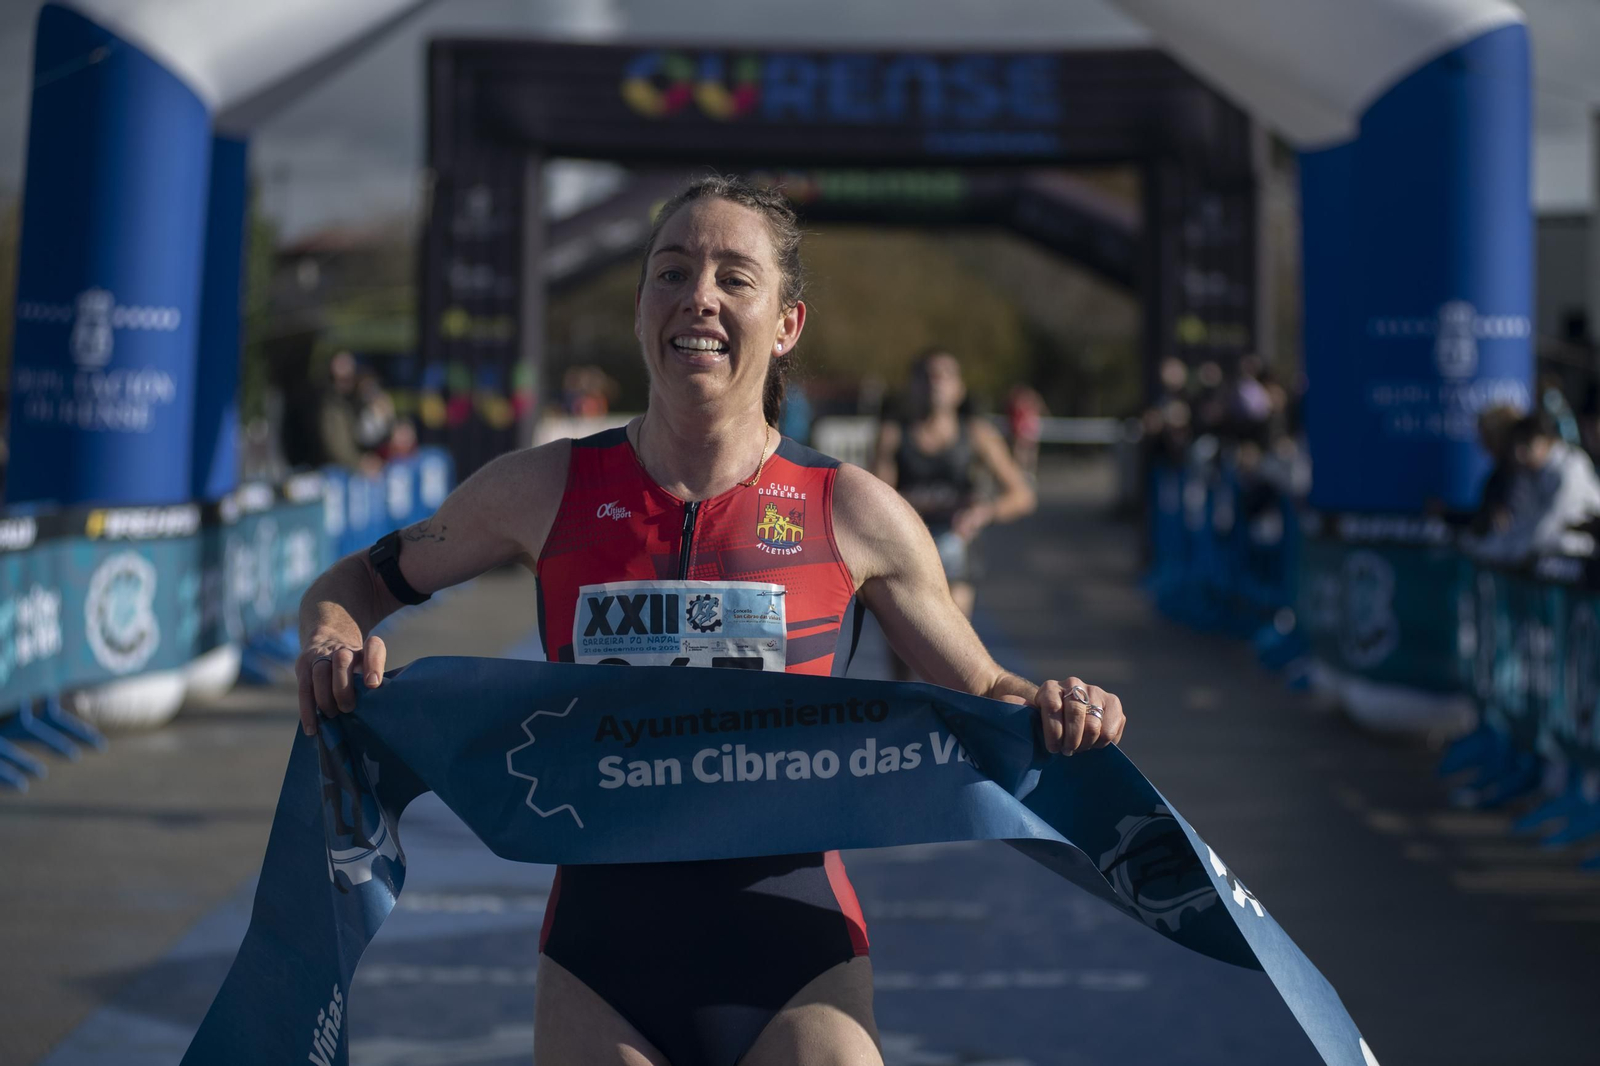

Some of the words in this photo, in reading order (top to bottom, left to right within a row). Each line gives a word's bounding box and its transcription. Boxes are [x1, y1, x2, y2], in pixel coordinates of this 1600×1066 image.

[622, 53, 1060, 120] OURENSE
[758, 488, 806, 500] OURENSE
[770, 482, 797, 493] CLUB
[612, 510, 632, 521] sport
[756, 543, 804, 556] ATLETISMO
[583, 594, 679, 636] XXII
[583, 637, 624, 646] CARREIRA
[630, 637, 643, 645] DO
[647, 636, 680, 645] NADAL
[595, 696, 889, 748] Ayuntamiento
[597, 751, 683, 790] San
[692, 742, 840, 785] Cibrao
[848, 737, 922, 778] das
[308, 983, 344, 1066] Viñas
